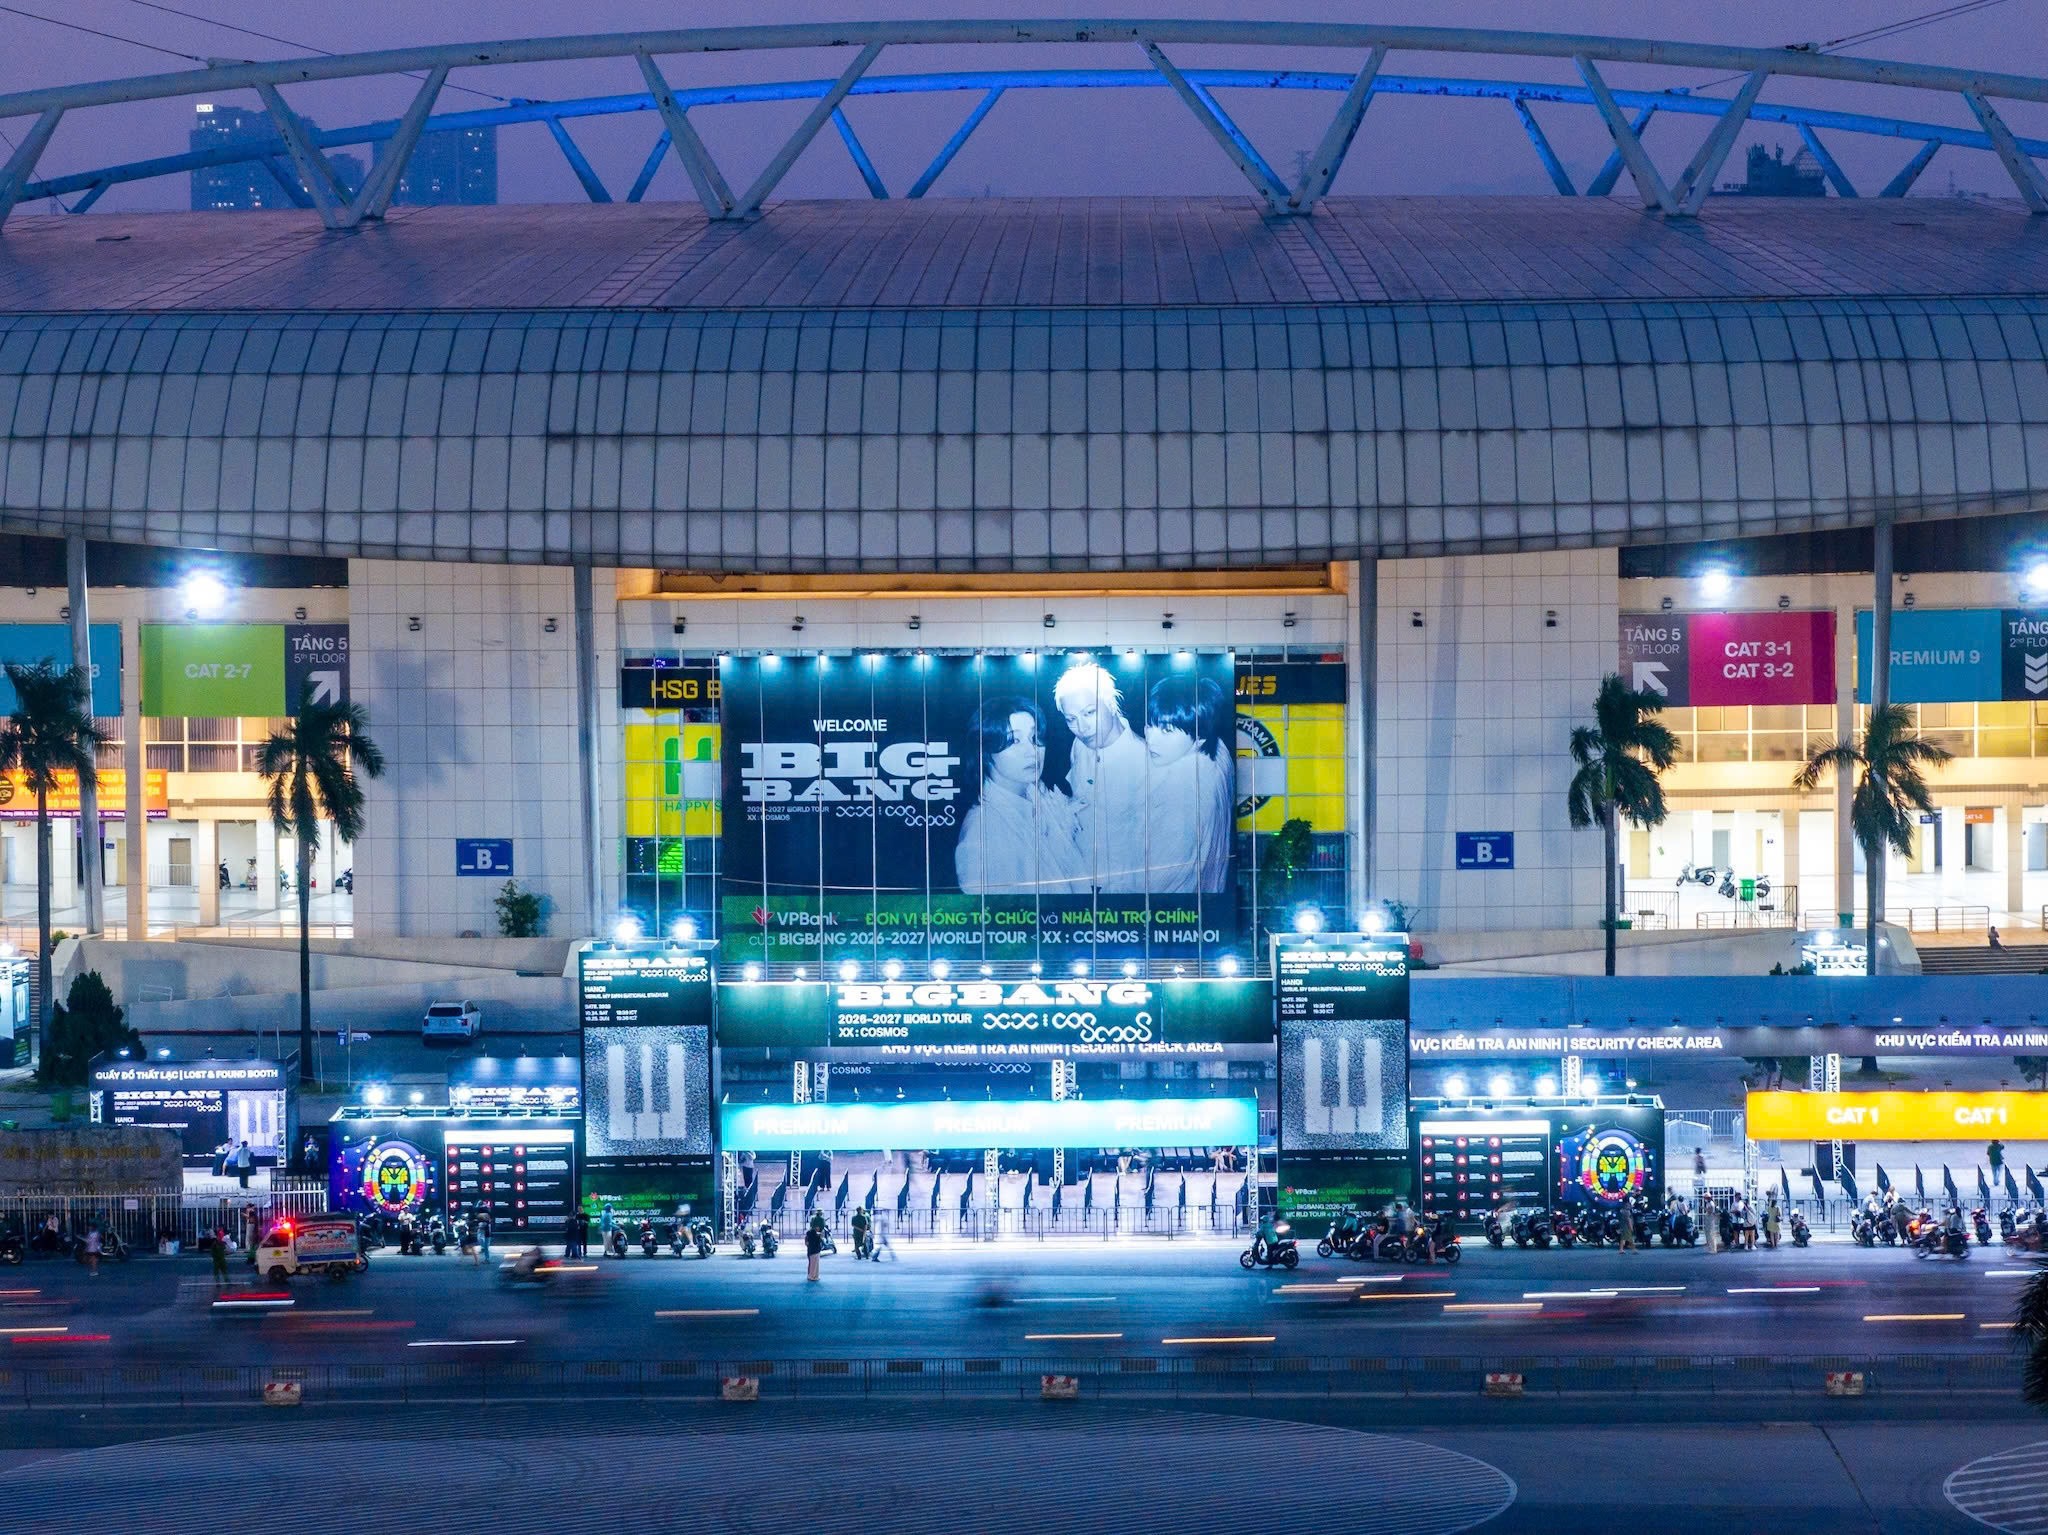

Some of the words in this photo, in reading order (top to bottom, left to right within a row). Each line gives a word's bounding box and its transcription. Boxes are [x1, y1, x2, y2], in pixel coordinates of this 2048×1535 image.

[1624, 625, 1667, 641] TẦNG
[1671, 628, 1681, 641] 5
[2009, 617, 2048, 634] TẦNG
[292, 633, 334, 650] TẦNG
[338, 638, 348, 650] 5
[1642, 644, 1680, 655] FLOOR
[1724, 642, 1761, 657] CAT
[1765, 641, 1792, 656] 3-1
[309, 653, 347, 664] FLOOR
[1889, 650, 1965, 666] REMIUM
[1969, 650, 1981, 664] 9
[185, 664, 221, 679] CAT
[224, 664, 252, 679] 2-7
[1723, 663, 1760, 679] CAT
[1763, 662, 1794, 678] 3-2
[651, 679, 699, 700] HSG
[813, 719, 888, 732] WELCOME
[740, 741, 961, 778] BIG
[741, 779, 961, 802] BANG
[665, 801, 709, 812] HAPPY
[477, 848, 492, 870] B
[1477, 842, 1493, 863] B
[777, 911, 838, 926] VPBank
[865, 911, 900, 926] ĐƠN
[903, 912, 918, 929] VỊ
[995, 907, 1037, 925] CHỨC
[1041, 911, 1059, 924] và
[1062, 909, 1094, 924] NHÀ
[1096, 908, 1119, 924] TÀI
[779, 932, 848, 946] BIGBANG
[850, 931, 925, 945] 2026-2027
[928, 931, 982, 945] WORLD
[987, 931, 1027, 944] TOUR
[1042, 931, 1063, 944] XX
[1073, 930, 1139, 944] COSMOS
[1154, 930, 1169, 943] IN
[1172, 930, 1220, 943] HANOI
[837, 983, 1152, 1007] BIGBANG
[903, 1013, 941, 1024] WORLD
[942, 1013, 972, 1024] TOUR
[838, 1027, 854, 1038] XX
[860, 1027, 909, 1038] COSMOS
[1875, 1035, 1905, 1047] KHU
[1907, 1033, 1936, 1050] VỰC
[1938, 1031, 1971, 1047] KIỂM
[1973, 1034, 2001, 1046] TRA
[2002, 1034, 2024, 1046] AN
[2026, 1034, 2048, 1046] NIN
[1008, 1044, 1029, 1054] AN
[1186, 1042, 1223, 1053] AREA
[1411, 1036, 1440, 1053] VỰC
[1441, 1034, 1475, 1050] KIỂM
[1477, 1037, 1505, 1049] TRA
[1506, 1037, 1528, 1049] AN
[1528, 1037, 1562, 1049] NINH
[1570, 1036, 1635, 1049] SECURITY
[1636, 1036, 1685, 1049] CHECK
[1685, 1036, 1723, 1049] AREA
[184, 1070, 207, 1079] LOST
[216, 1070, 246, 1079] FOUND
[247, 1069, 278, 1078] BOOTH
[831, 1066, 872, 1075] COSMOS
[933, 1116, 1030, 1133] PREMIUM
[1115, 1115, 1212, 1132] PREMIUM
[1826, 1107, 1867, 1125] CAT
[1870, 1107, 1879, 1124] 1
[1954, 1107, 1994, 1125] CAT
[1998, 1107, 2008, 1124] 1
[753, 1118, 848, 1135] PREMIUM
